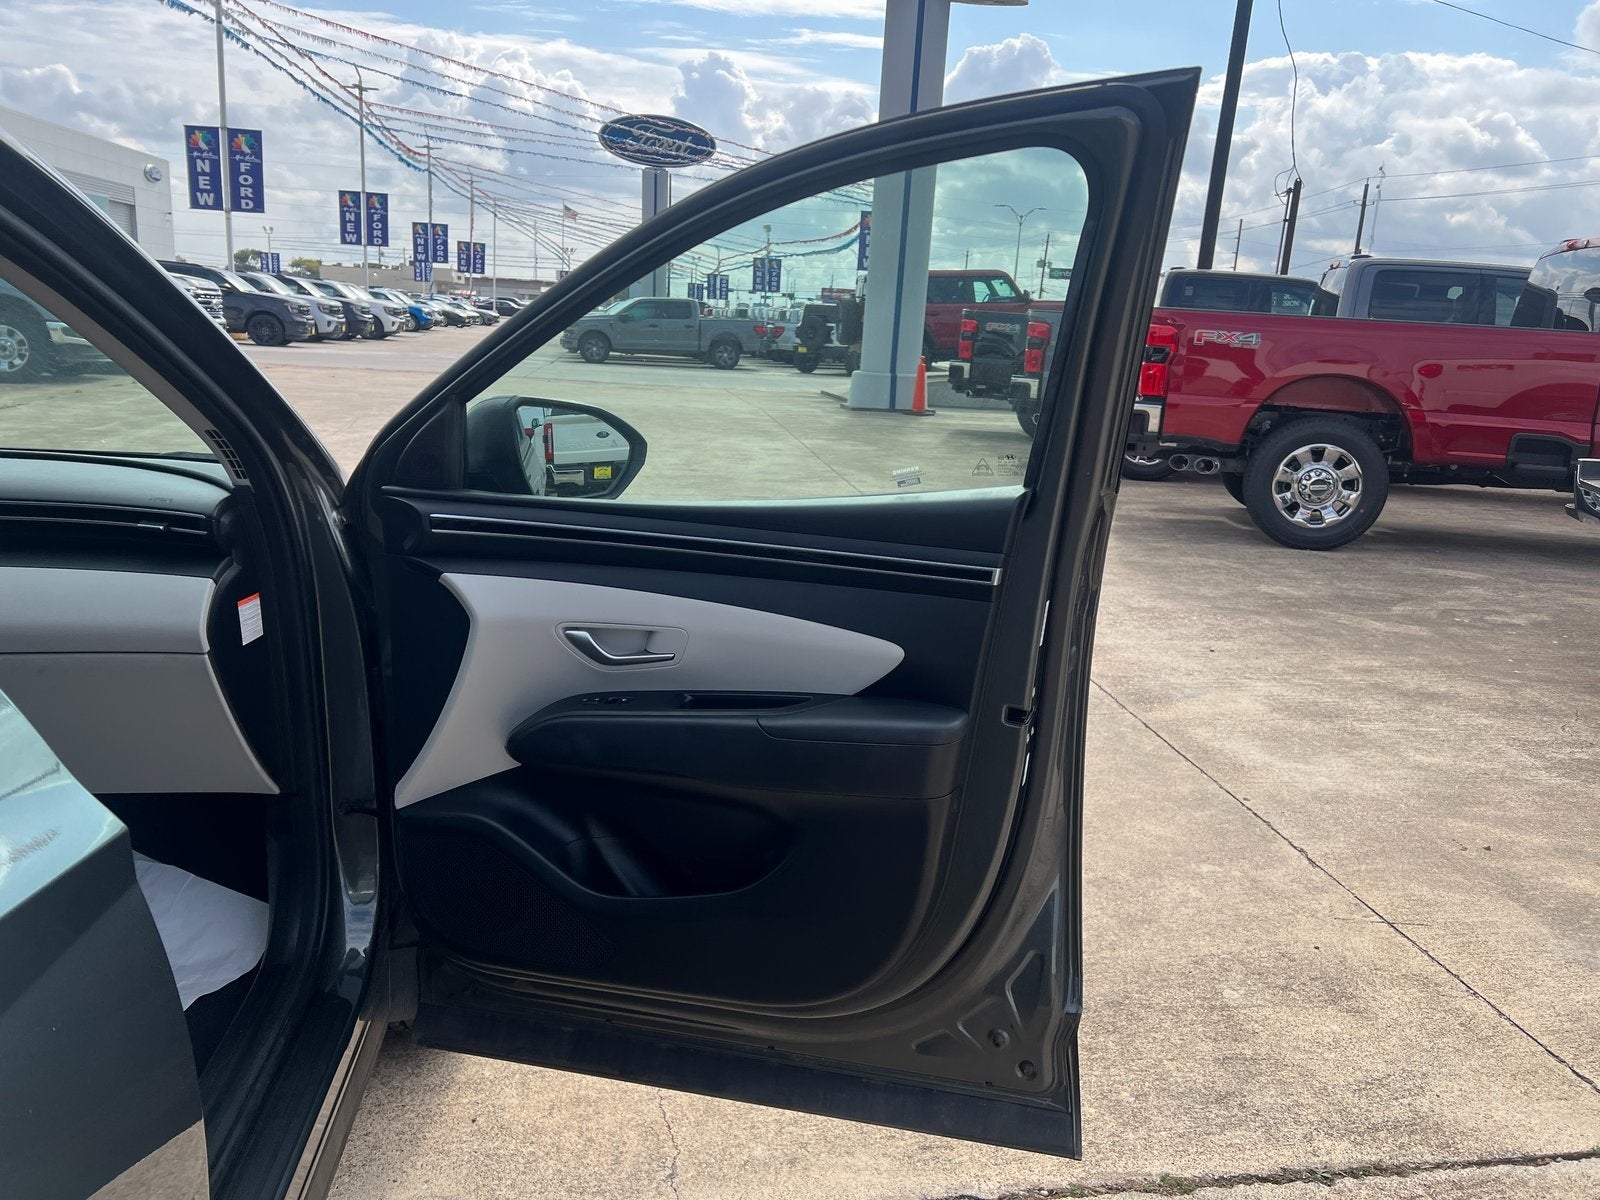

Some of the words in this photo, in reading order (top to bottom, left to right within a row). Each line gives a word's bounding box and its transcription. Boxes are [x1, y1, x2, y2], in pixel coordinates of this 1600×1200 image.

[625, 124, 694, 153] Ford
[196, 159, 214, 206] NEW
[239, 162, 254, 209] FORD
[345, 212, 357, 243] NEW
[372, 214, 382, 245] FORD
[416, 238, 426, 260] NEW
[436, 239, 444, 262] FORD
[460, 253, 468, 272] NEW
[754, 271, 763, 290] NEW
[1193, 329, 1262, 347] FX4
